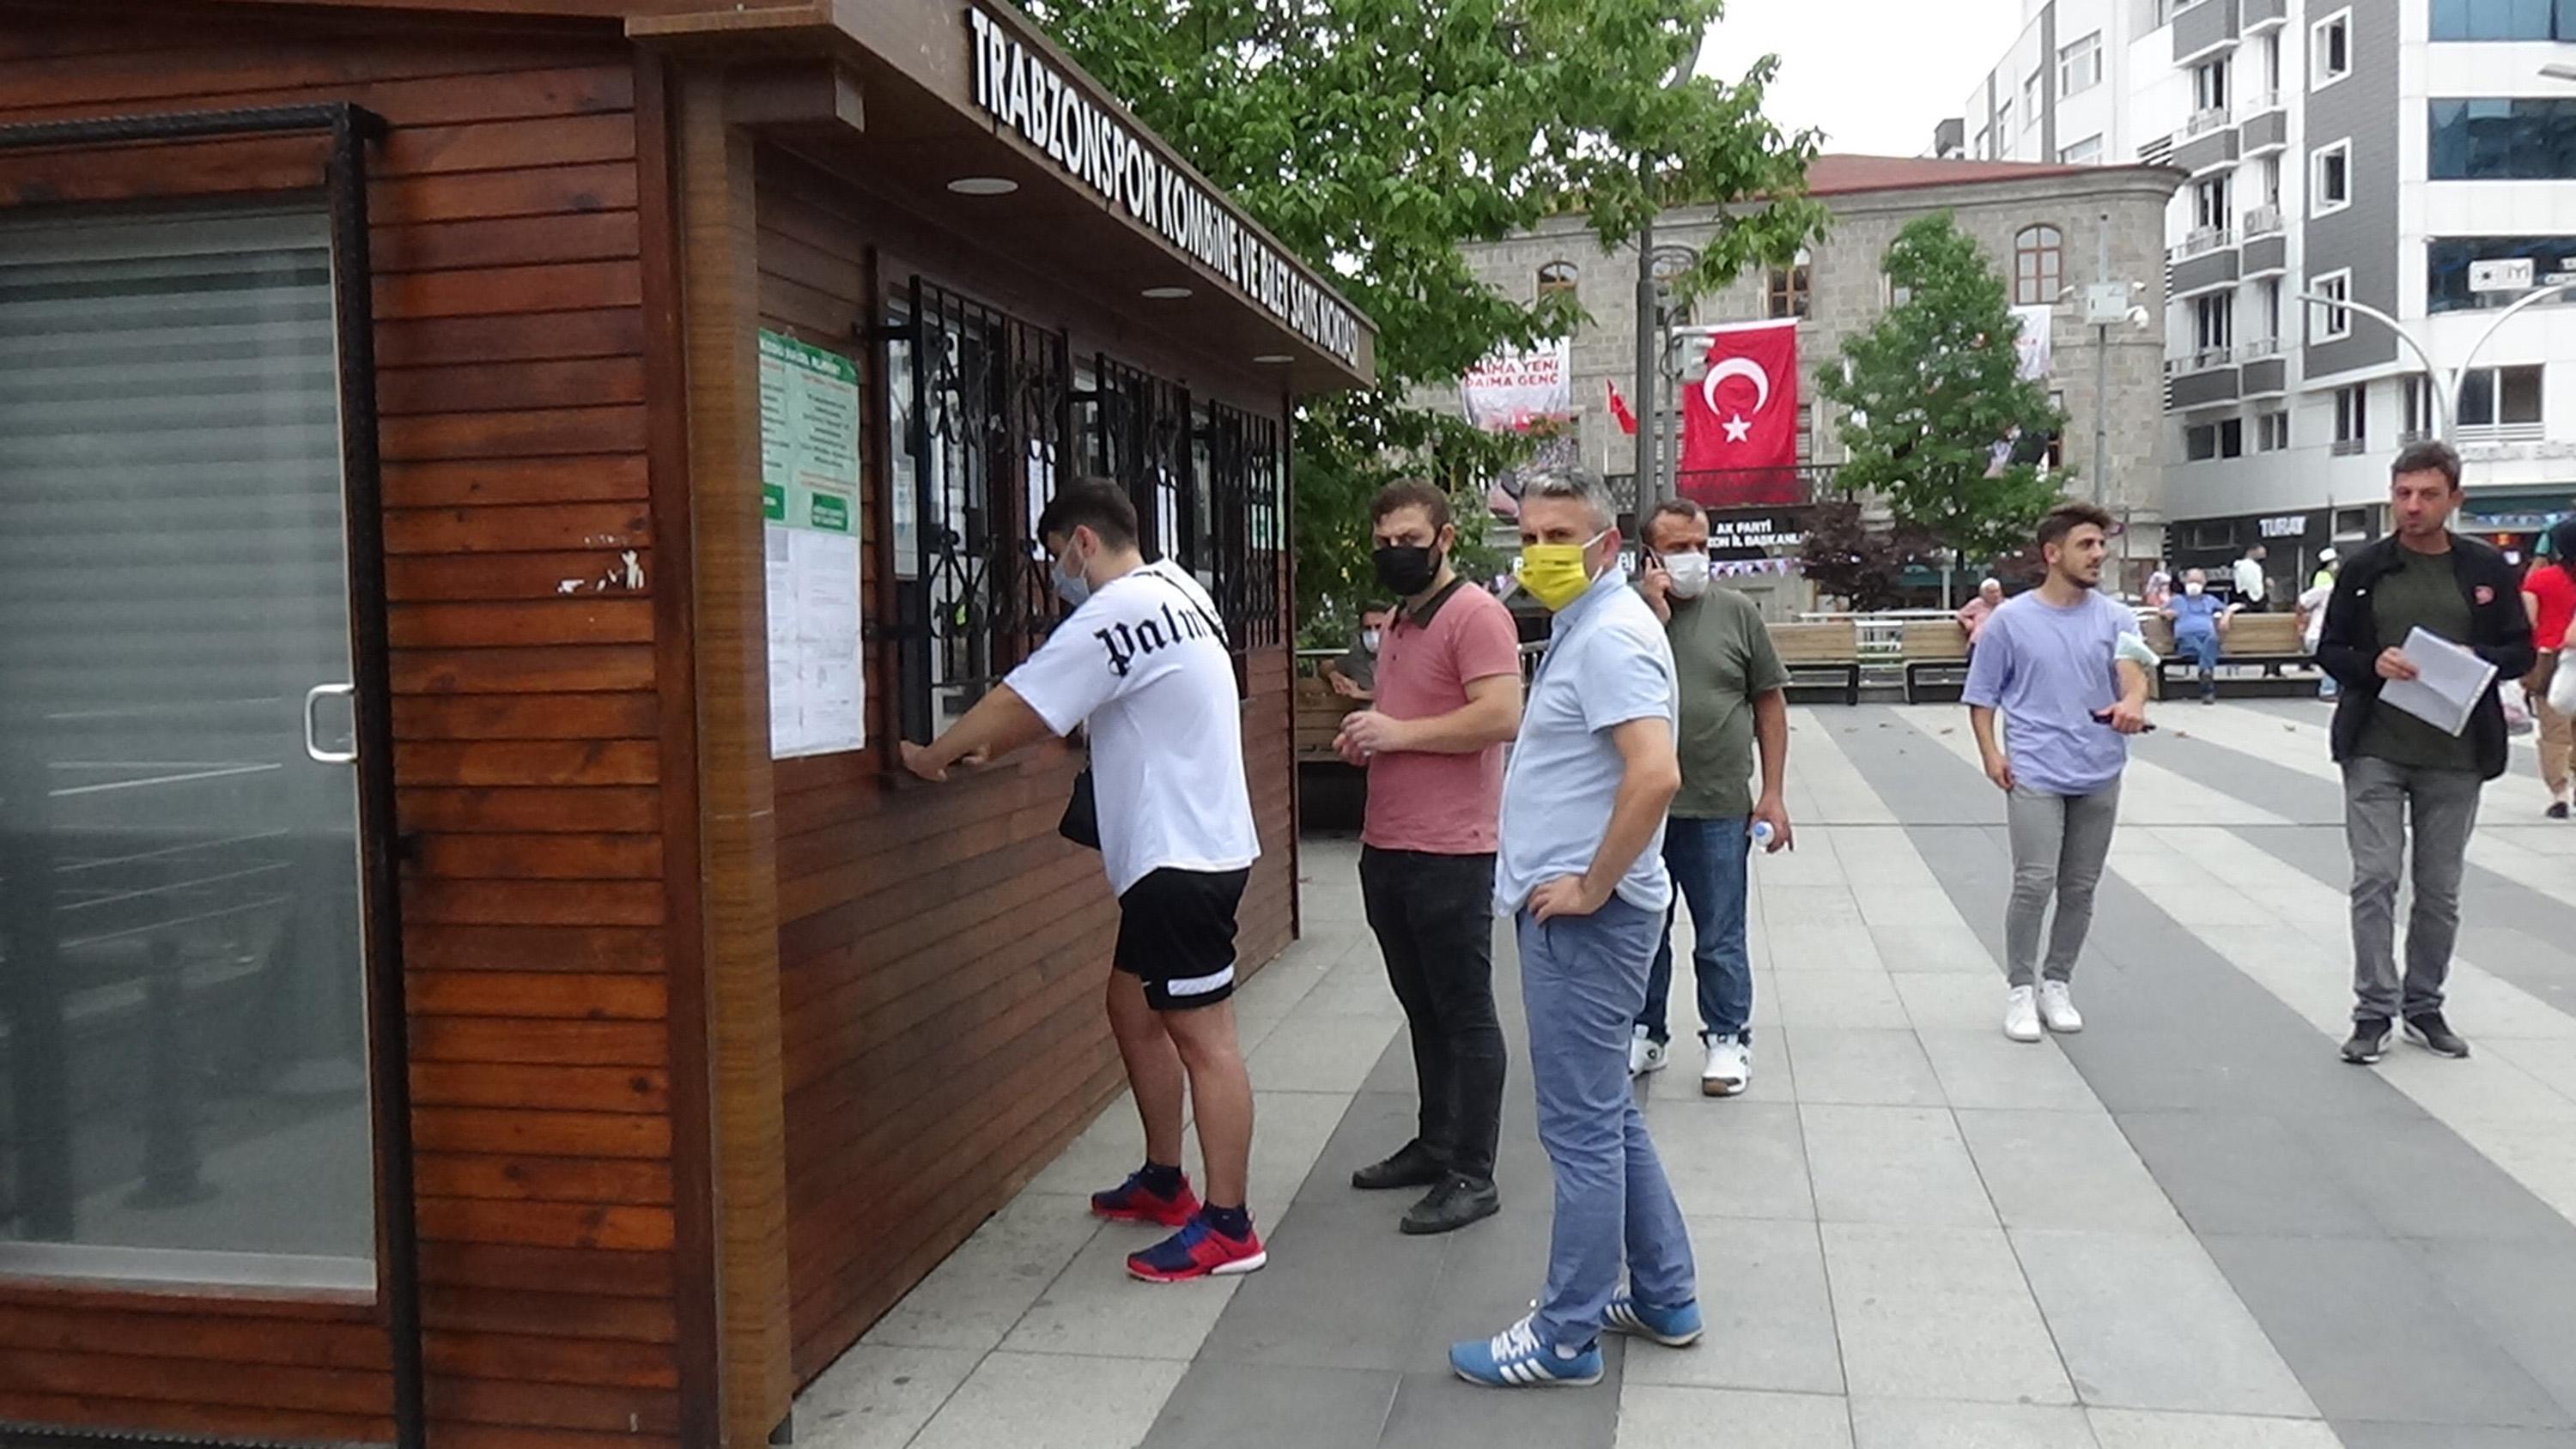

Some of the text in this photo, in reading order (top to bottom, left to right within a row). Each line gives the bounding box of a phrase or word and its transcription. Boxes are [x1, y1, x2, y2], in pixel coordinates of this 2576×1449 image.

[972, 7, 1157, 227] TRABZONSPOR
[1161, 164, 1238, 282] KOMBİNE
[1239, 228, 1259, 299] VE
[1716, 518, 1771, 534] AK PARTİ
